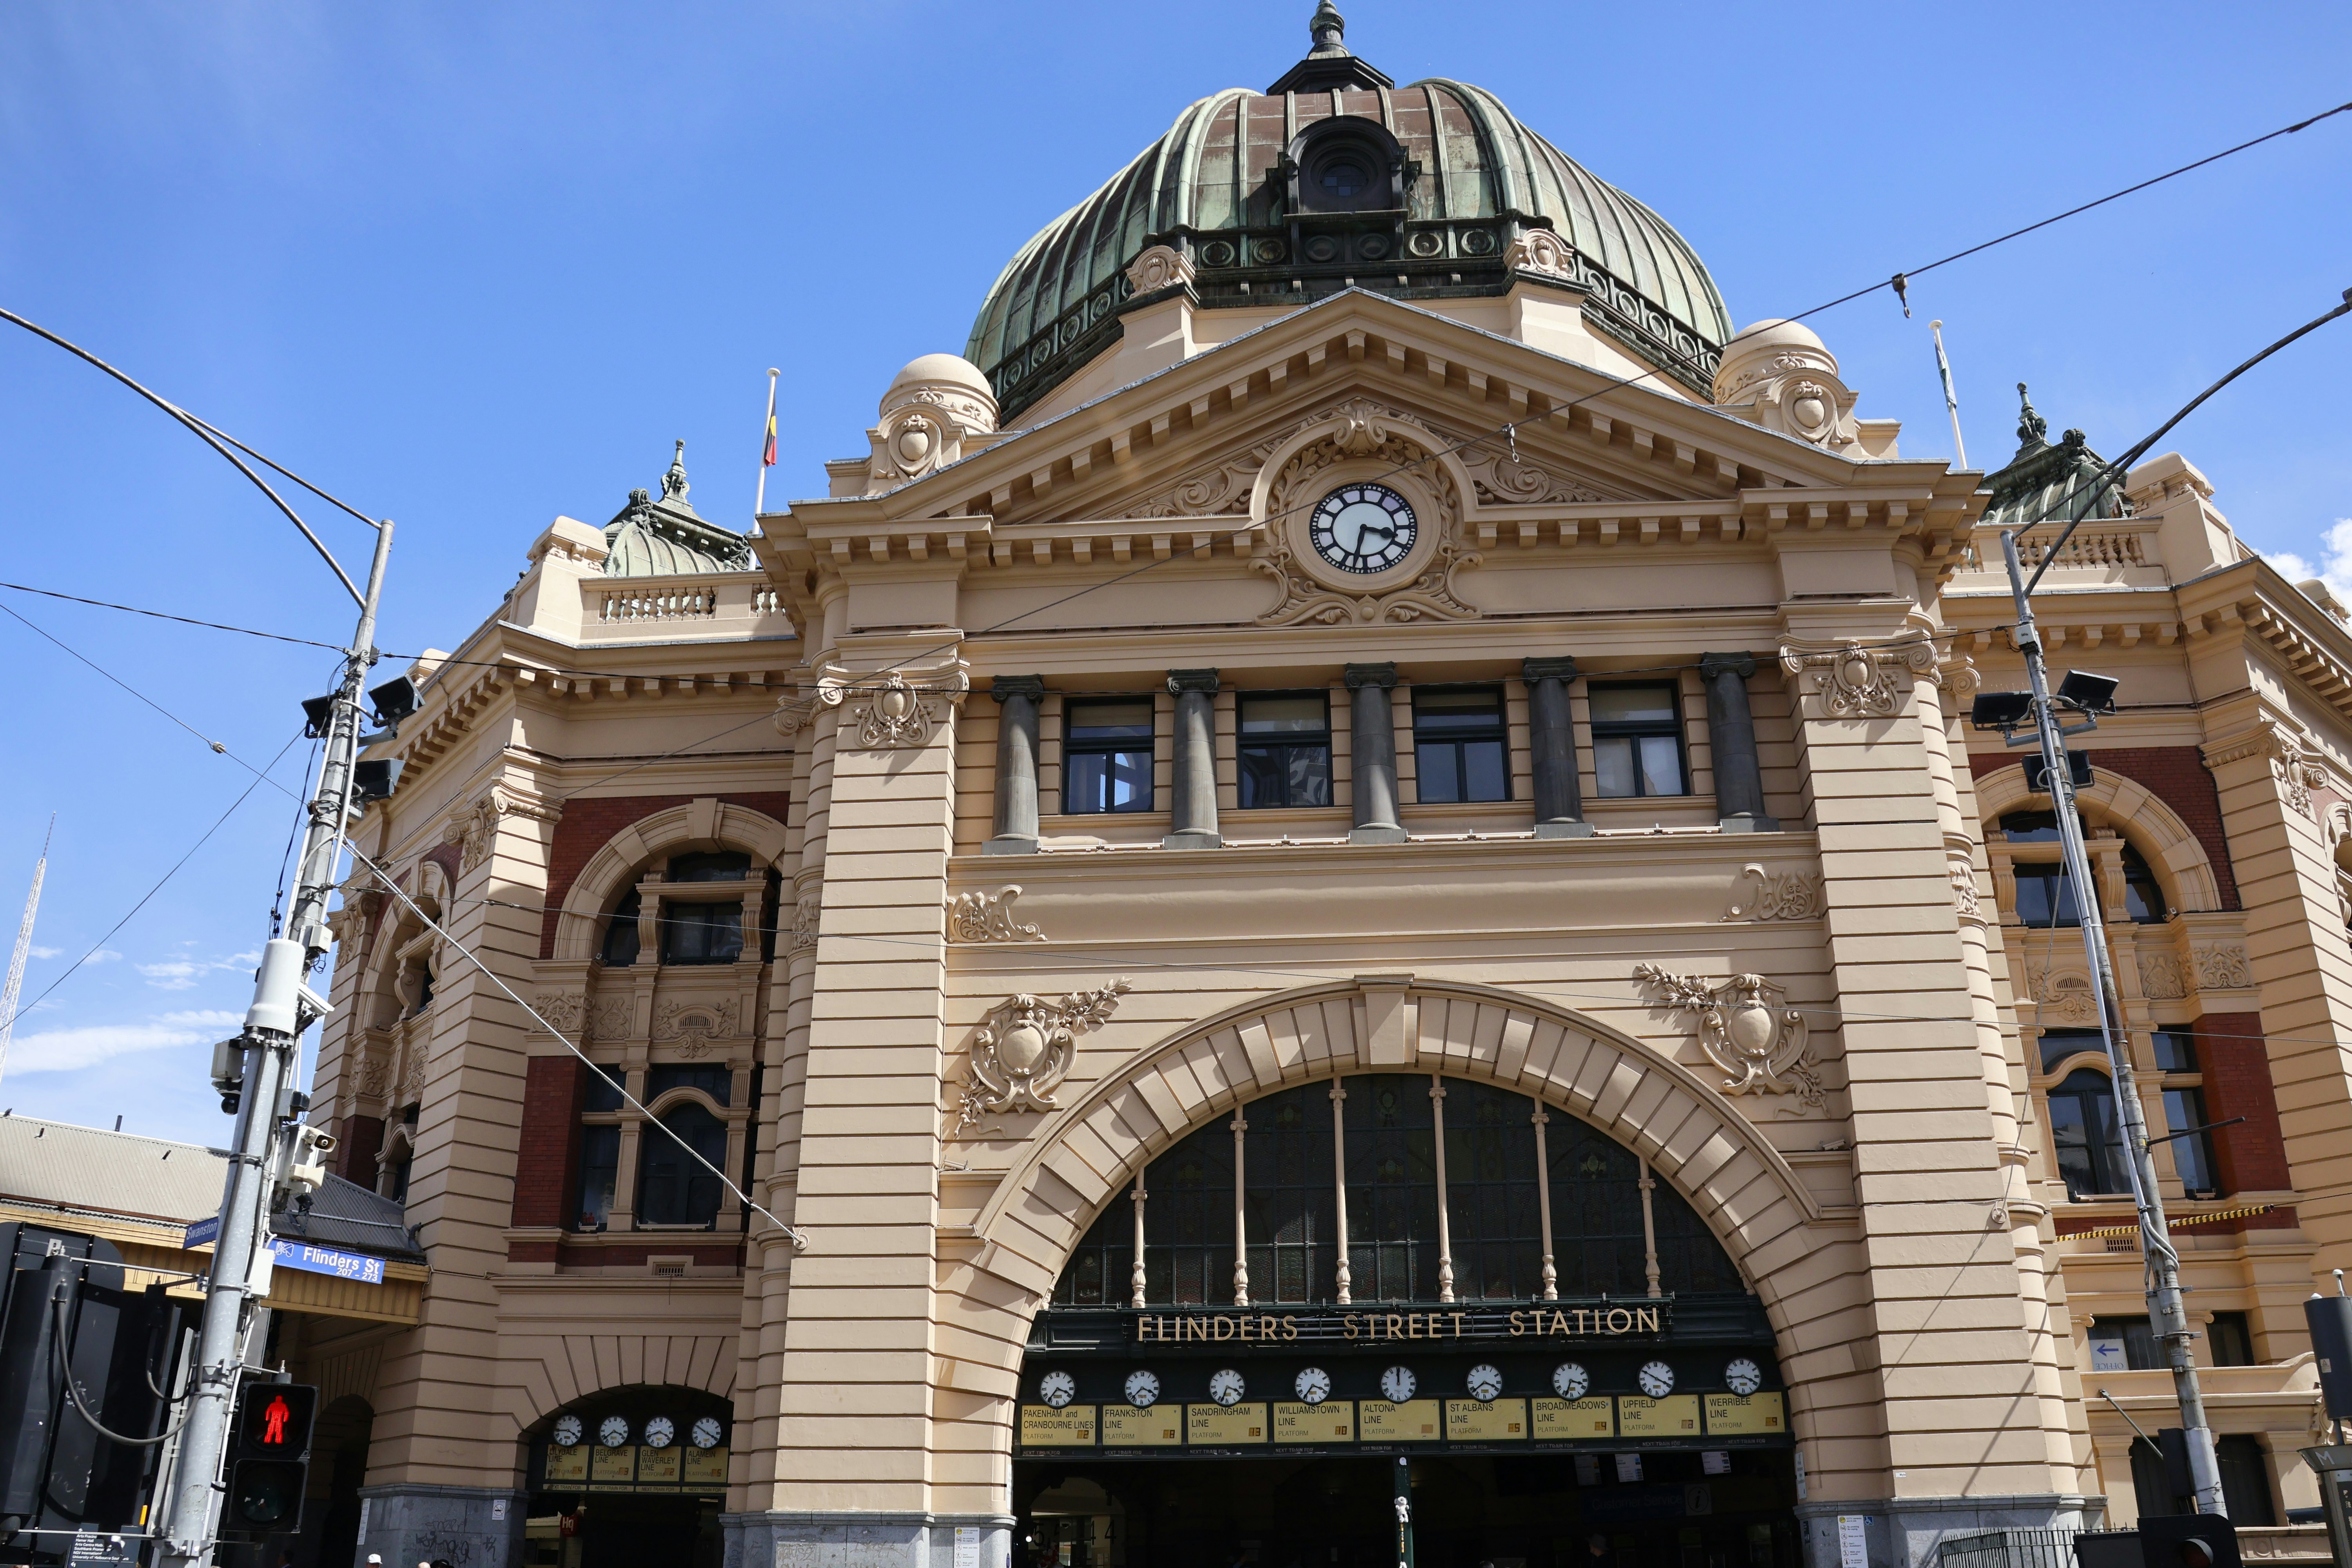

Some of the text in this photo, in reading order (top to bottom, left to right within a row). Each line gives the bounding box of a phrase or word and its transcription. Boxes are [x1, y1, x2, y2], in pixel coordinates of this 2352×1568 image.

[186, 1221, 217, 1240] Swanston
[303, 1247, 379, 1274] Flinders St
[337, 1268, 352, 1277] 207
[362, 1272, 378, 1281] 273
[1138, 1307, 1658, 1341] FLINDERS STREET STATION
[1537, 1401, 1605, 1410] BROADMEADOWS
[1623, 1400, 1656, 1408] UPFIELD
[1710, 1398, 1751, 1406] WERRIBEE
[1192, 1407, 1250, 1416] SANDRINGHAM
[1024, 1421, 1072, 1429] CRANBOURNE
[1592, 1494, 1682, 1511] Customer Service
[563, 1517, 574, 1532] Hq
